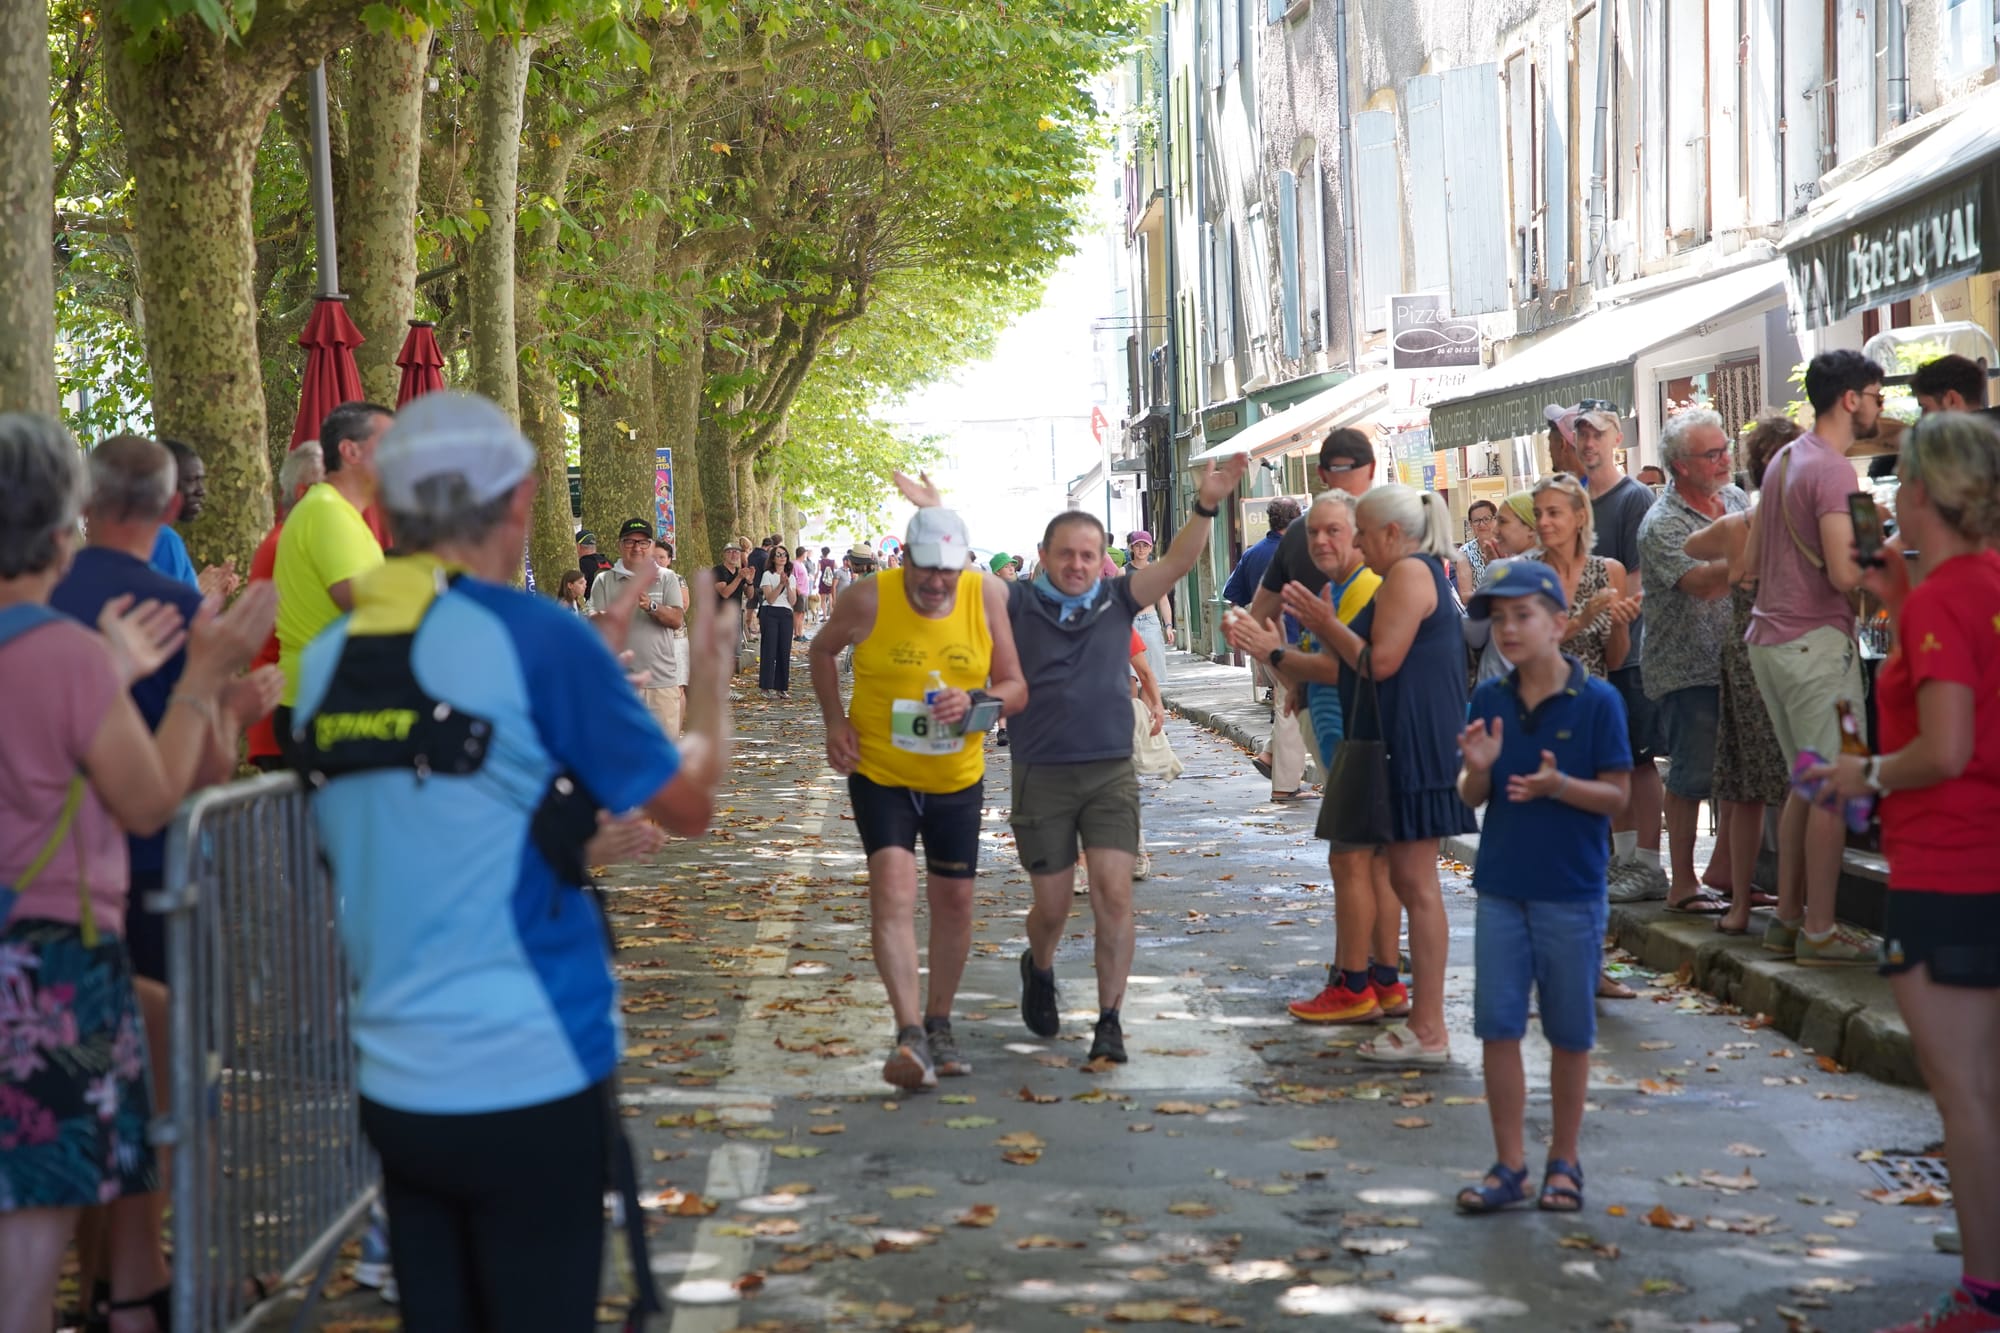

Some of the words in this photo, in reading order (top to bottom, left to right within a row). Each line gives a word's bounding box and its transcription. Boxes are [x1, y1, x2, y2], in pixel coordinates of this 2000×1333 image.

[1847, 228, 1895, 299] DÉDÉ
[1897, 224, 1927, 281] DU
[1931, 202, 1980, 268] VAL
[1397, 305, 1451, 325] Pizze
[1433, 408, 1471, 445] BOUCHERIE
[1475, 396, 1529, 438] CHARCUTERIE
[1531, 385, 1576, 426] MAISON
[1248, 511, 1268, 525] GL
[912, 716, 928, 737] 6
